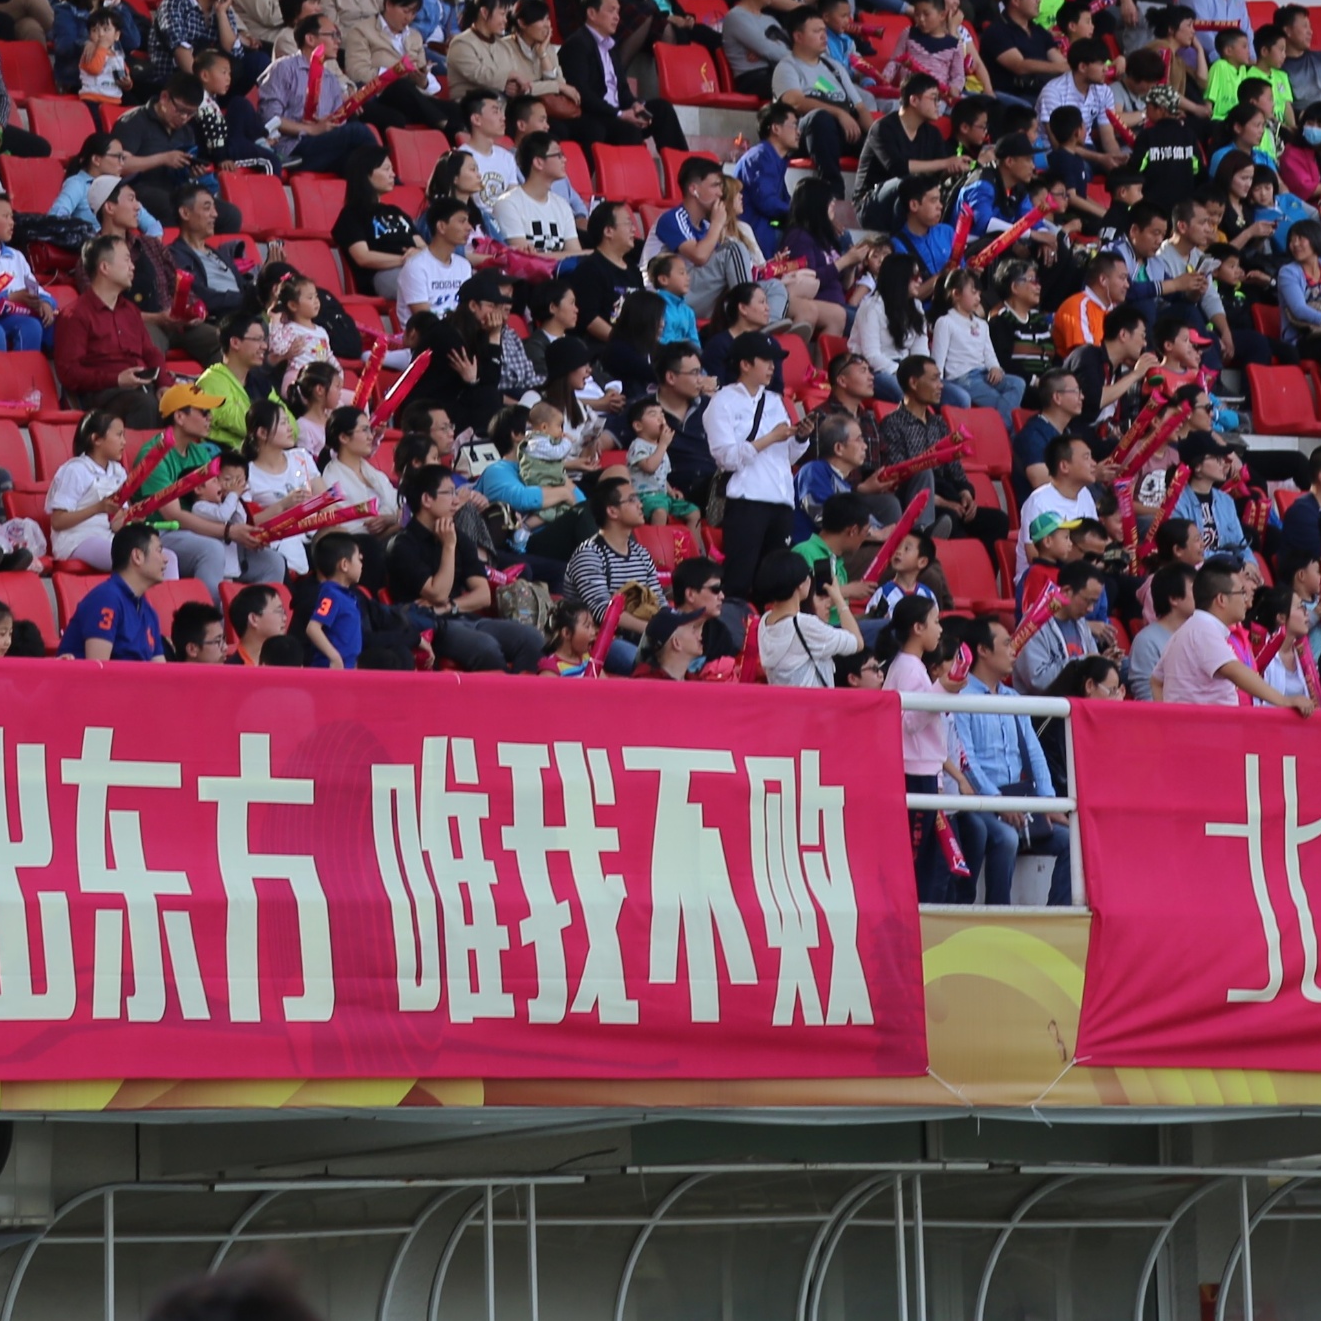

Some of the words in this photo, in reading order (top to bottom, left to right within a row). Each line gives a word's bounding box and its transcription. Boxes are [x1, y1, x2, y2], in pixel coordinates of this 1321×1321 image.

[99, 606, 115, 631] 3
[317, 597, 333, 617] 3
[369, 735, 875, 1027] 唯我不败
